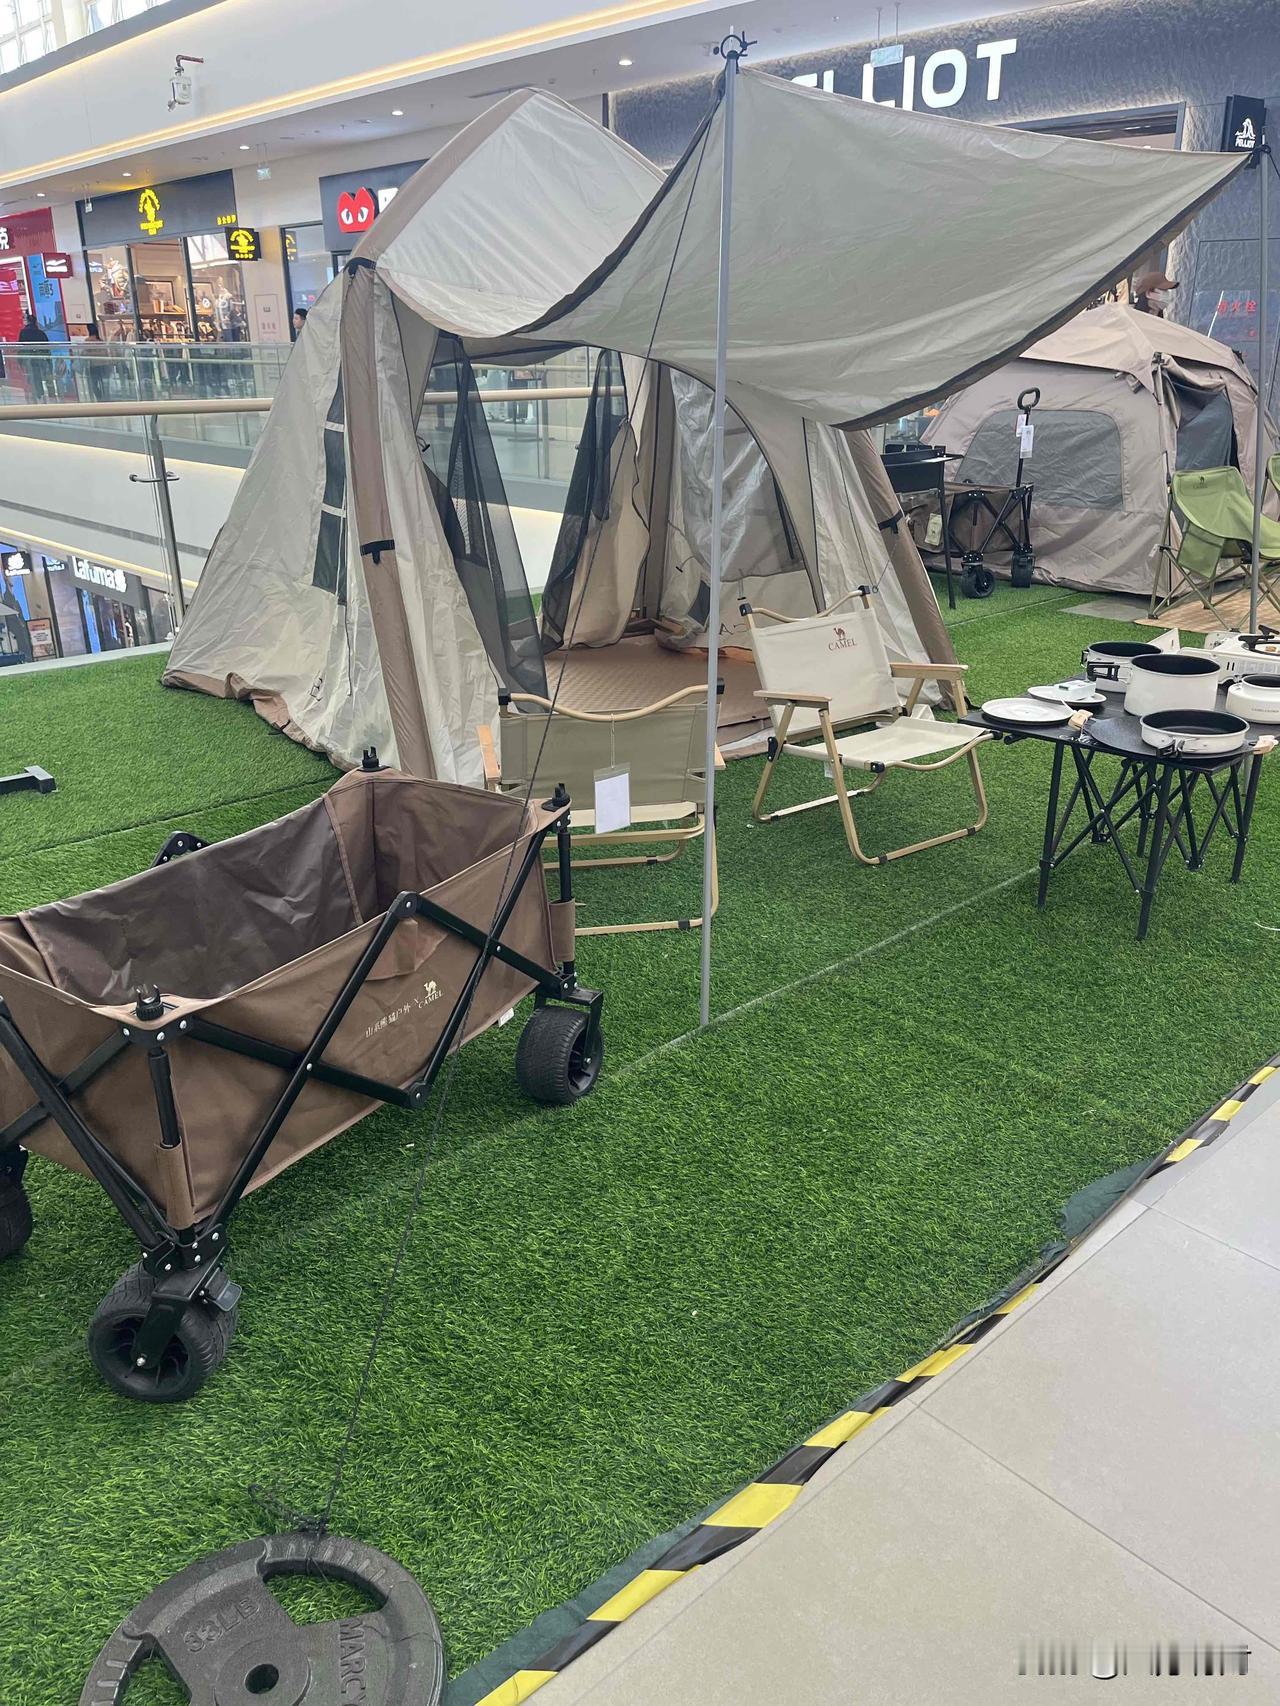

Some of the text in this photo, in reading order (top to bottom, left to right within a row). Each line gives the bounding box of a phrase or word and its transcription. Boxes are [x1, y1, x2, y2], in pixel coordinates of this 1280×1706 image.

[72, 556, 116, 589] Lafuma
[828, 638, 857, 651] CAMEL
[418, 989, 443, 1009] CAMEL
